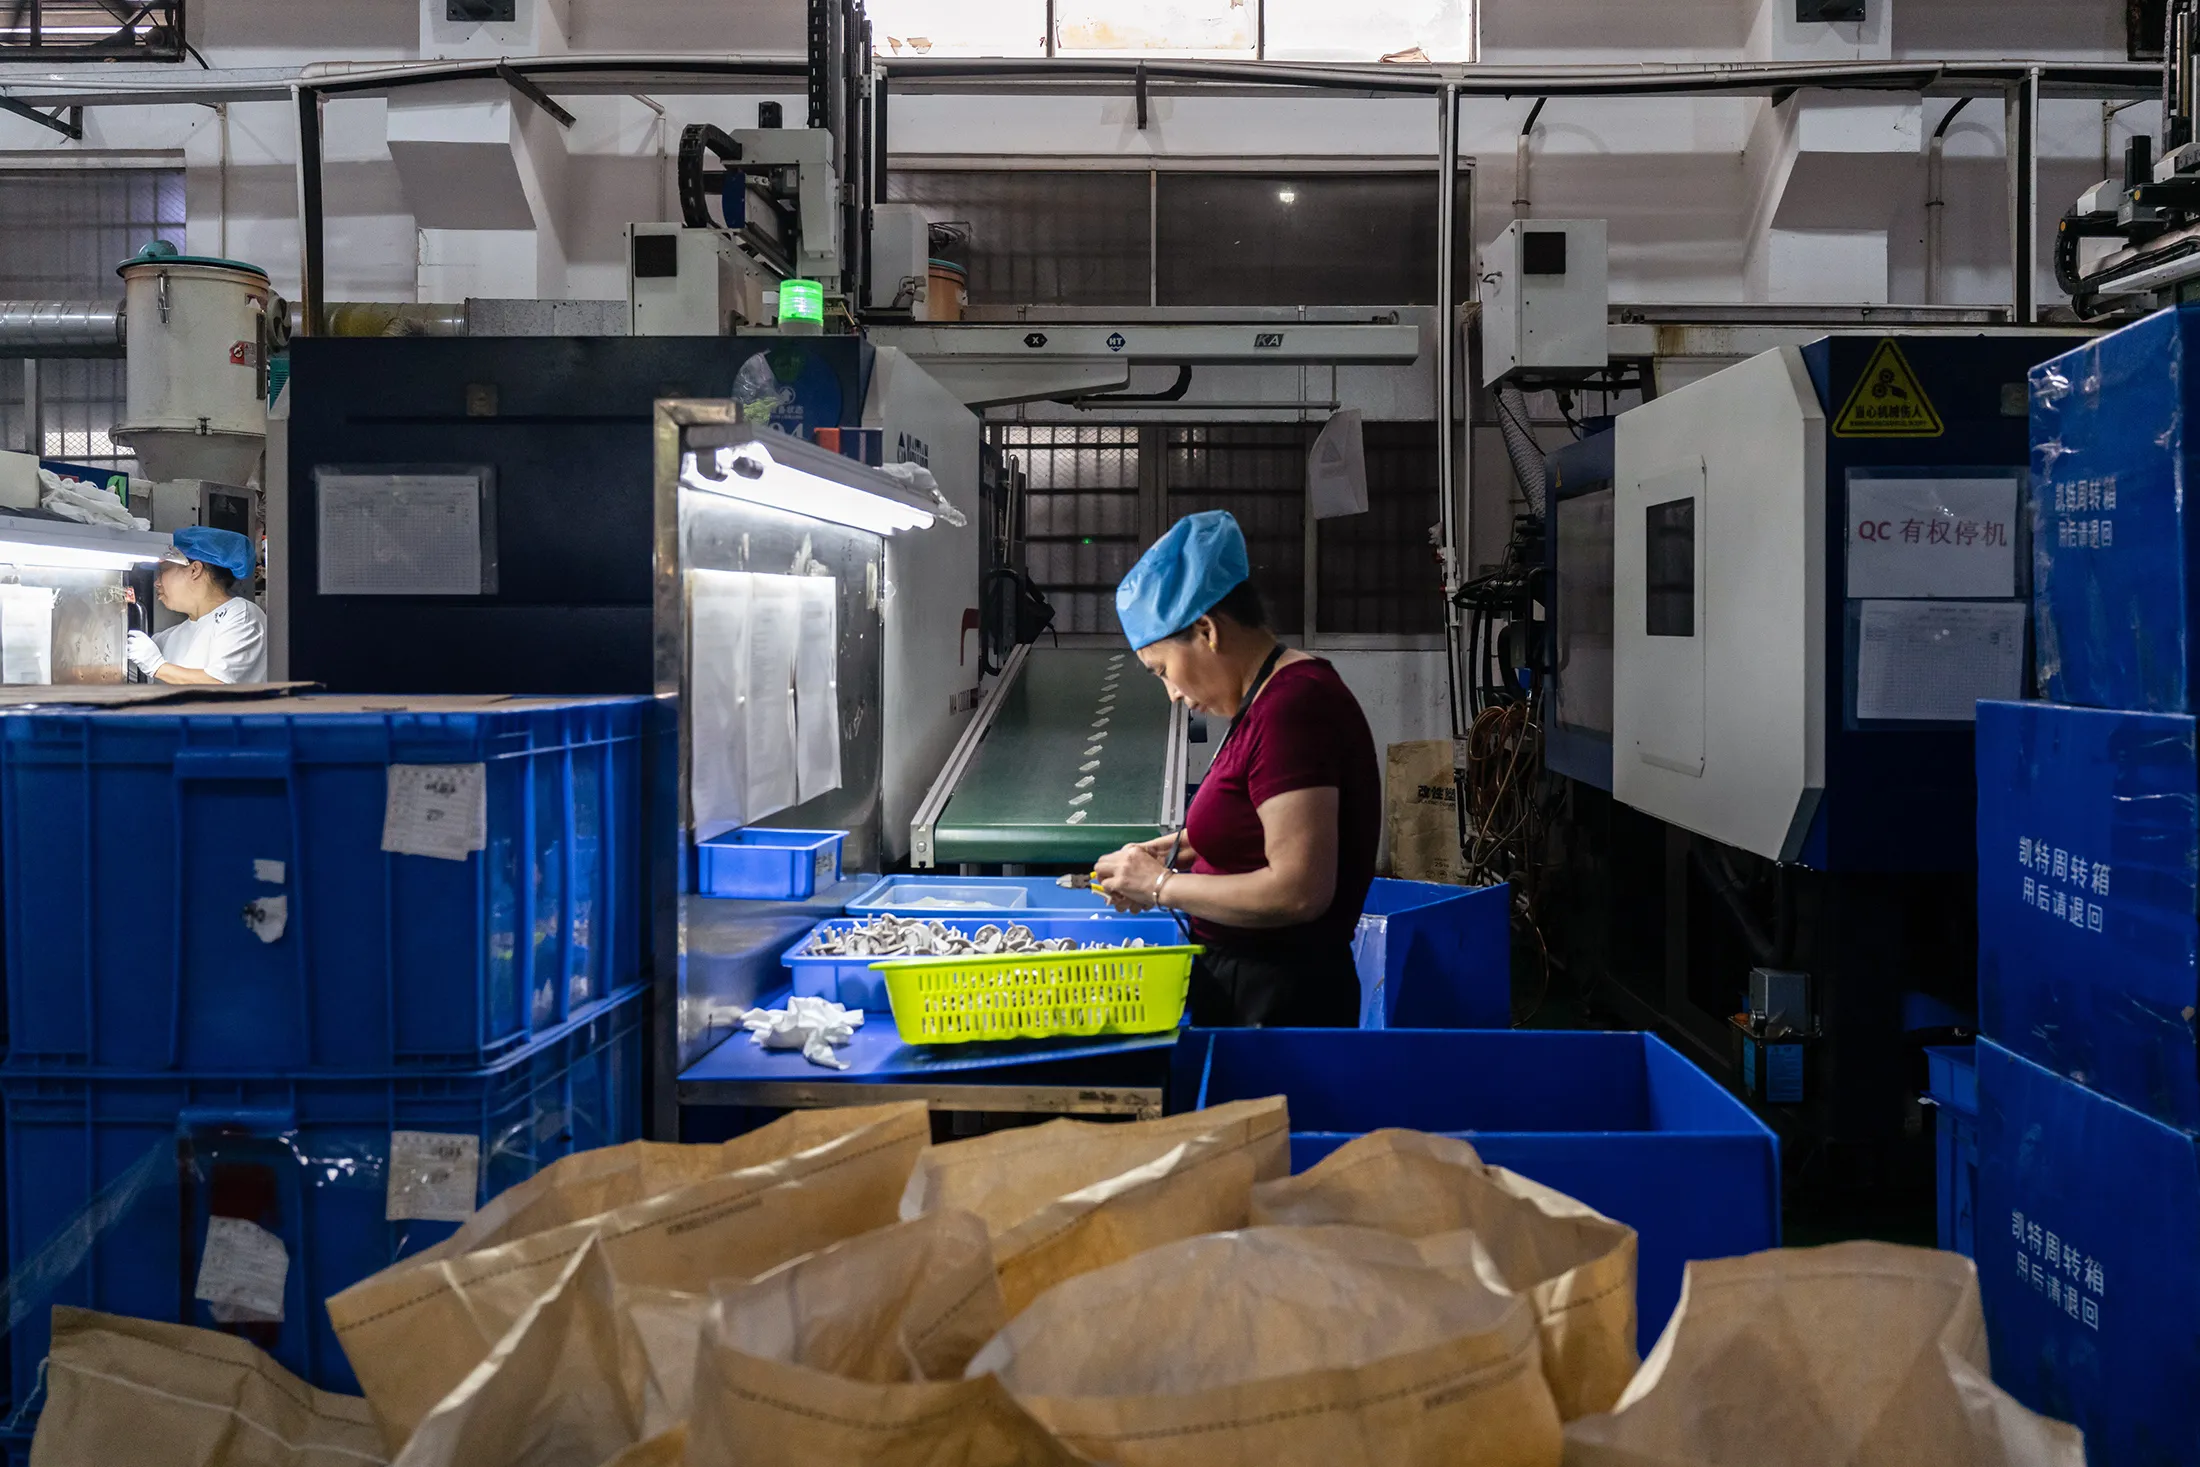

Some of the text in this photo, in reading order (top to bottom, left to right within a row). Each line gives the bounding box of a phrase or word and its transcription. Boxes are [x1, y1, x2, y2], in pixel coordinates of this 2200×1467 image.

[1109, 337, 1123, 346] HT
[1256, 334, 1280, 346] KA
[1858, 518, 2007, 546] QC 有权停机
[2019, 835, 2112, 896] 凯特周转箱
[2022, 876, 2103, 933] 用后请退回
[2011, 1208, 2104, 1297] 凯特周转箱
[2016, 1250, 2099, 1332] 用后请退回
